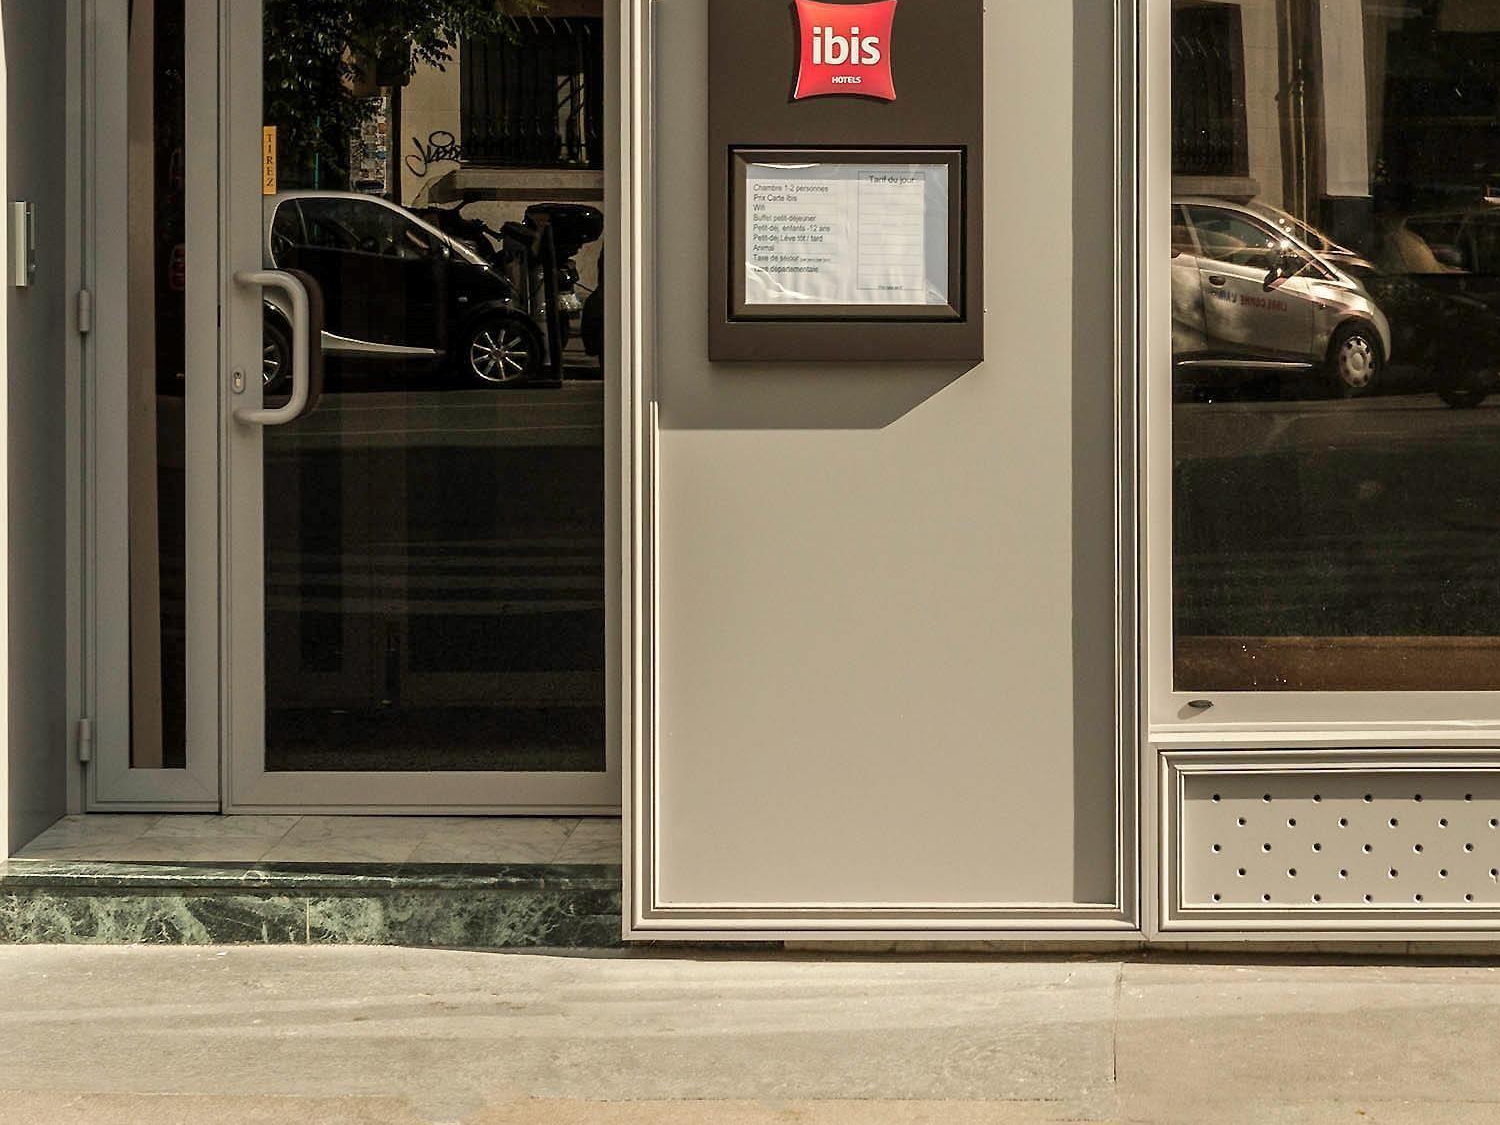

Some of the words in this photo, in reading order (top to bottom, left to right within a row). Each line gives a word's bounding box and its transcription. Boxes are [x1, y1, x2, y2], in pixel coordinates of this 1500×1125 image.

[813, 26, 881, 65] ibis
[831, 76, 862, 84] HOTELS
[265, 133, 274, 187] TIREZ
[869, 175, 887, 184] Tarif
[887, 176, 898, 184] du
[753, 183, 782, 192] Chambre
[795, 185, 829, 193] personnes
[753, 193, 766, 202] Prix
[769, 254, 779, 262] de
